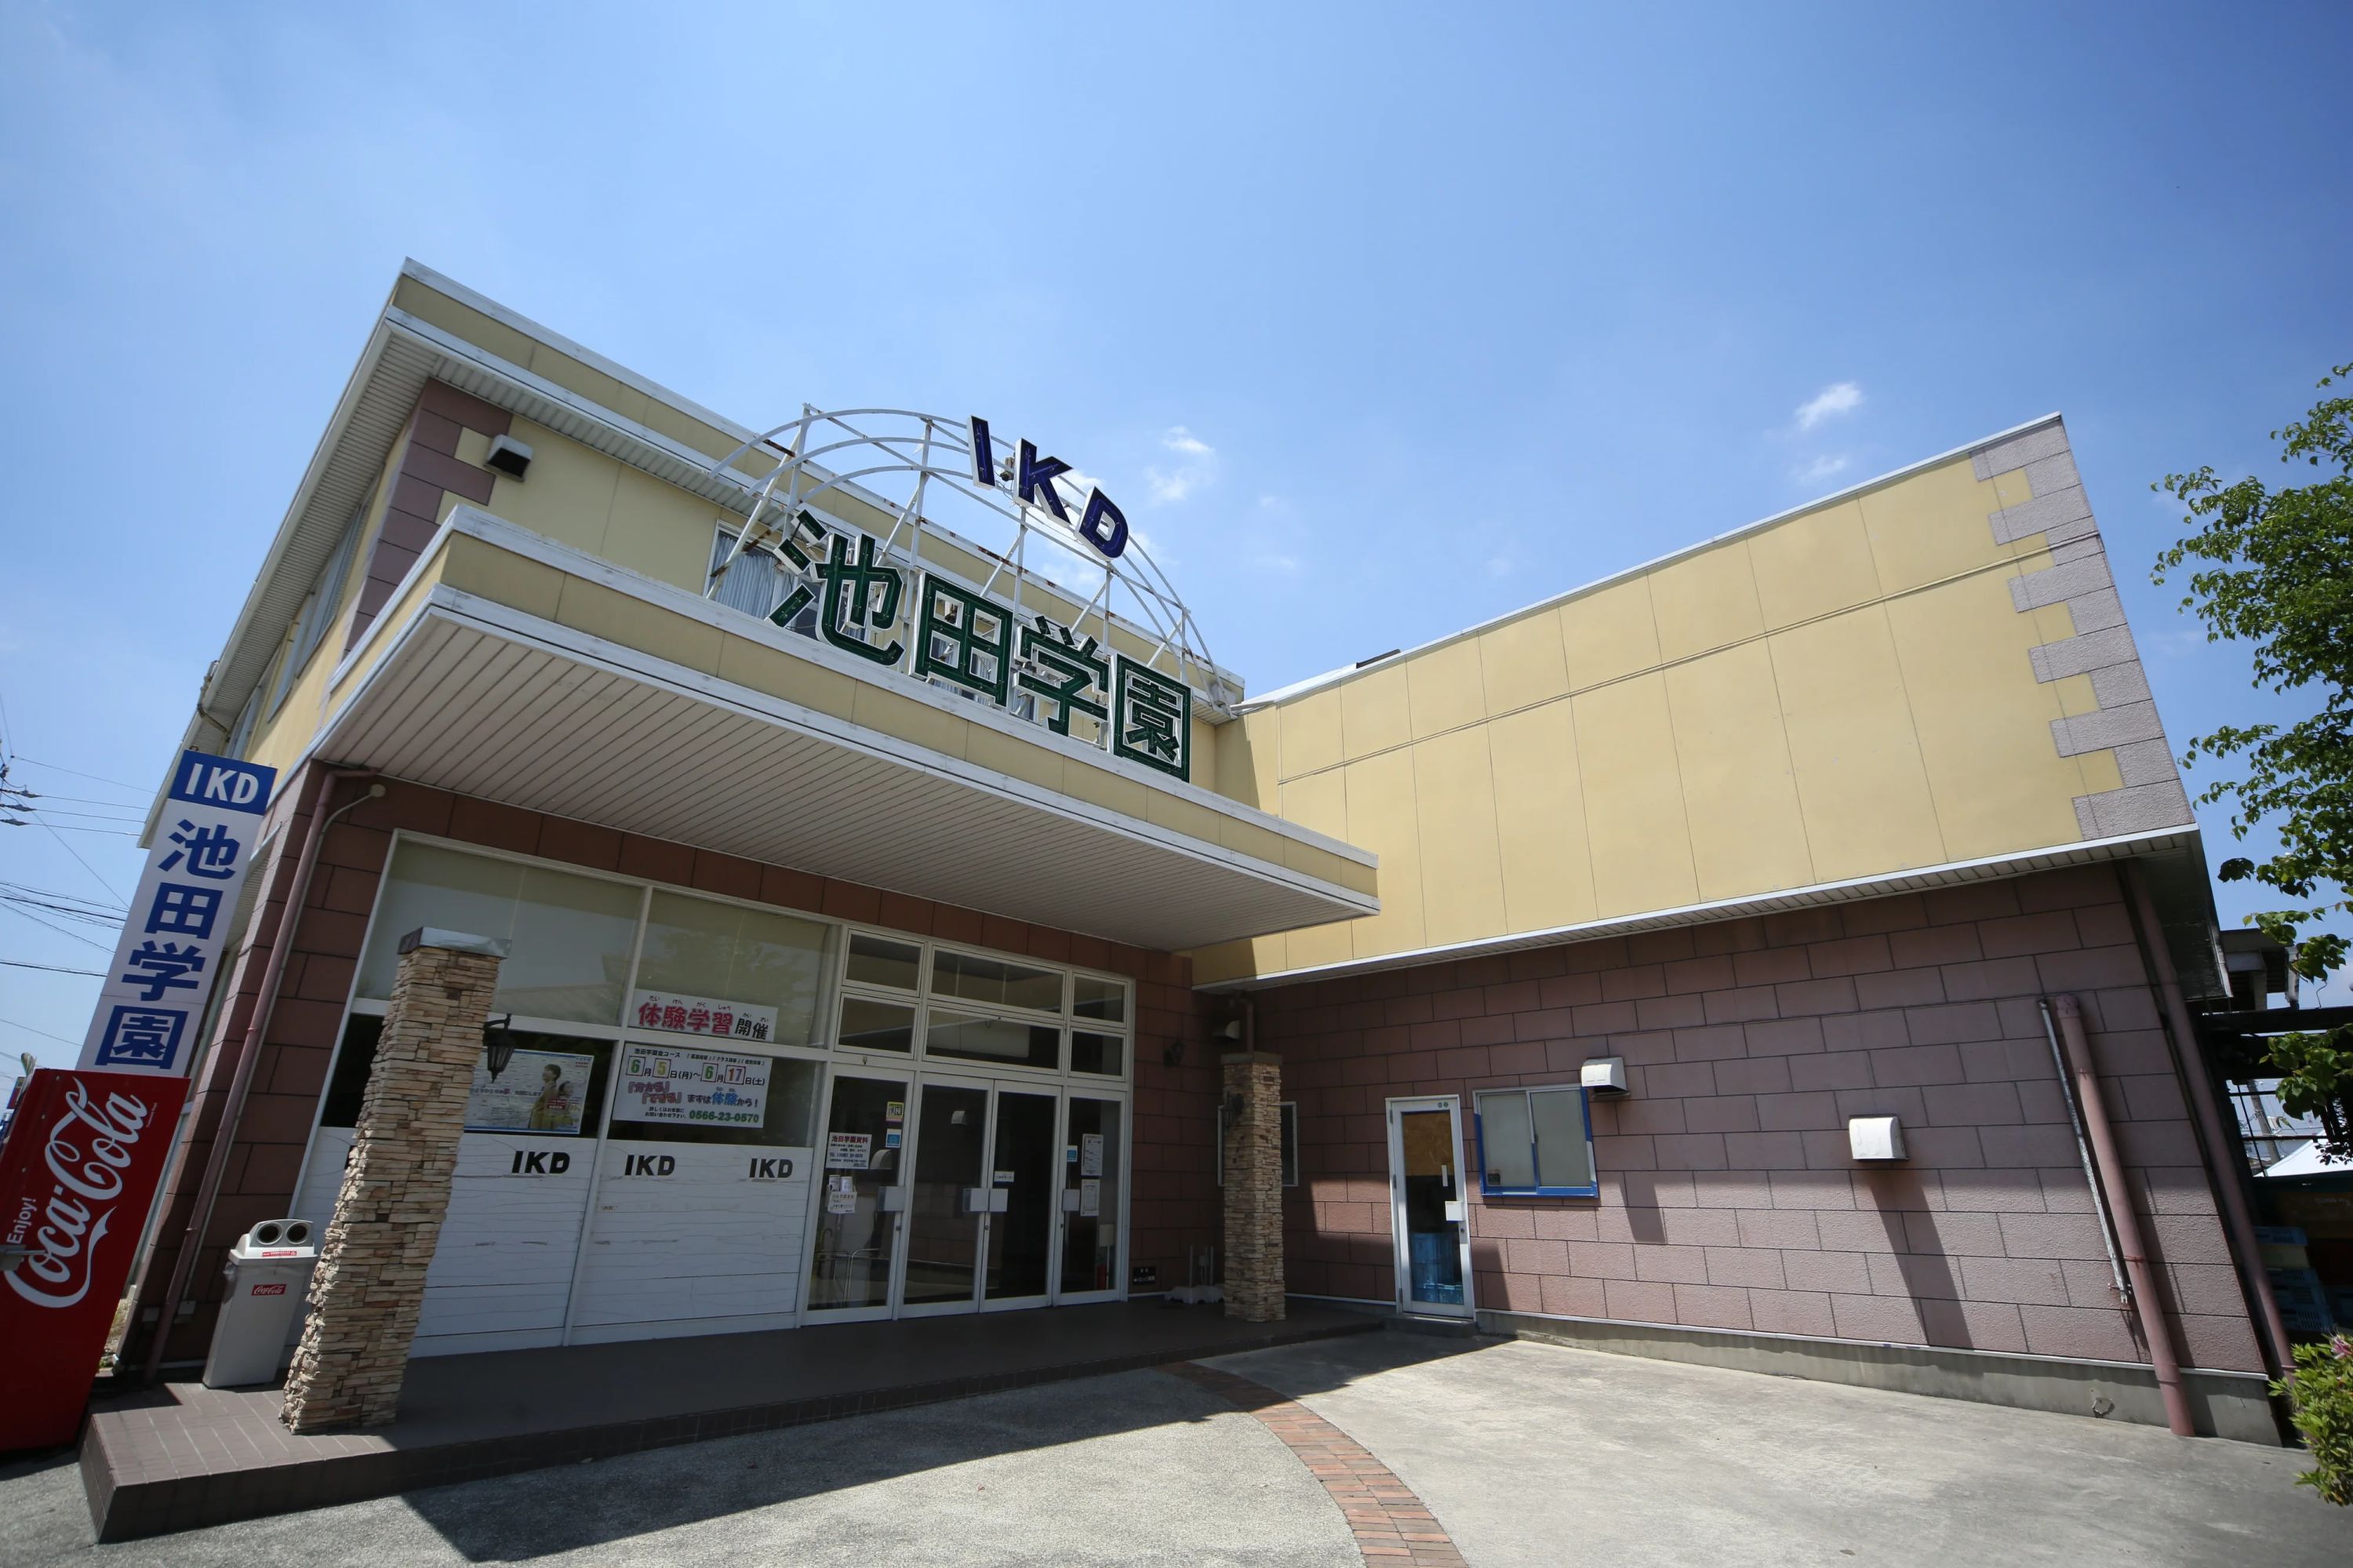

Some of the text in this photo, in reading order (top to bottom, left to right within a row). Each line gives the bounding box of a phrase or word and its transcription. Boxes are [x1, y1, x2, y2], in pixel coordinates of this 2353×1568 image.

[966, 414, 1129, 560] IKD
[766, 509, 1193, 784] 池田学園
[184, 762, 260, 806] IKD
[95, 818, 241, 1071] 池田学園
[638, 1002, 769, 1040] 体験学習開催
[689, 1110, 759, 1122] 0566-23-0570
[511, 1150, 570, 1175] IKD
[624, 1154, 675, 1176] IKD
[749, 1158, 793, 1178] IKD
[6, 1196, 37, 1244] Enjoy!
